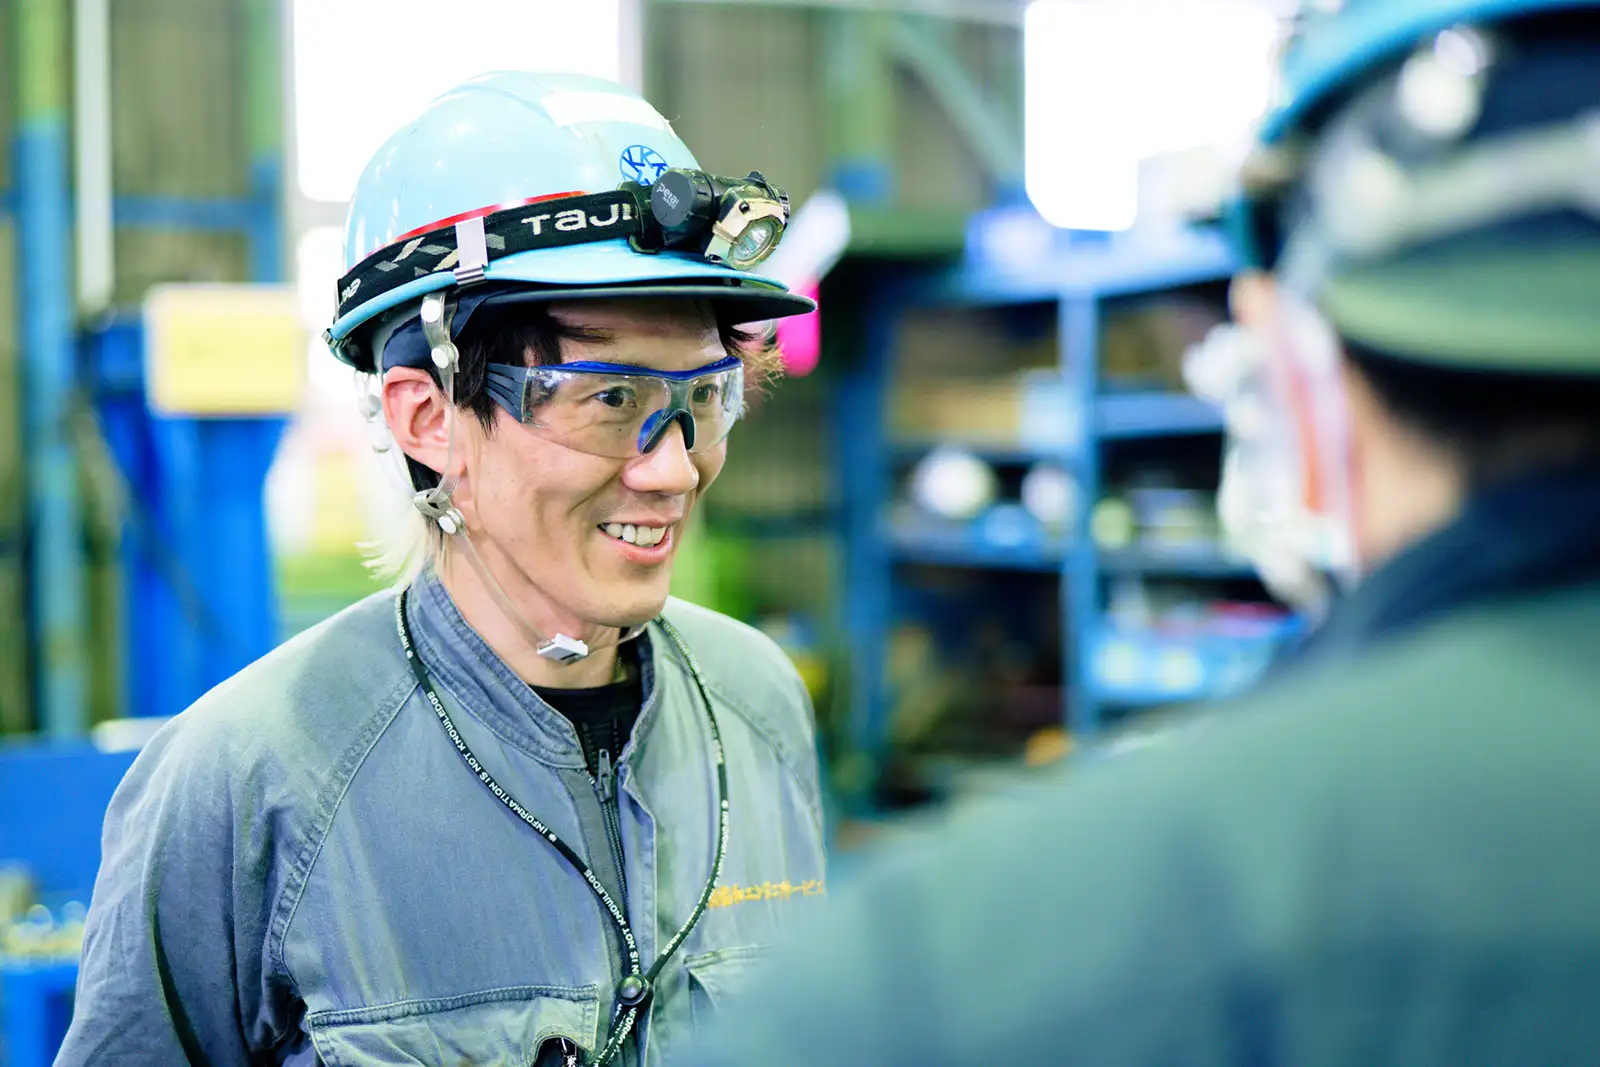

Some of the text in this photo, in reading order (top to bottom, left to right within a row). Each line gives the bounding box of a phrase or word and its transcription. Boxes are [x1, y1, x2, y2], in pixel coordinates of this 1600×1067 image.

[427, 691, 548, 834] INFORMATION IS NOT KNOWLEDGE
[584, 869, 626, 926] KNOWLEDGE
[622, 927, 635, 949] NOT
[630, 951, 639, 962] IS
